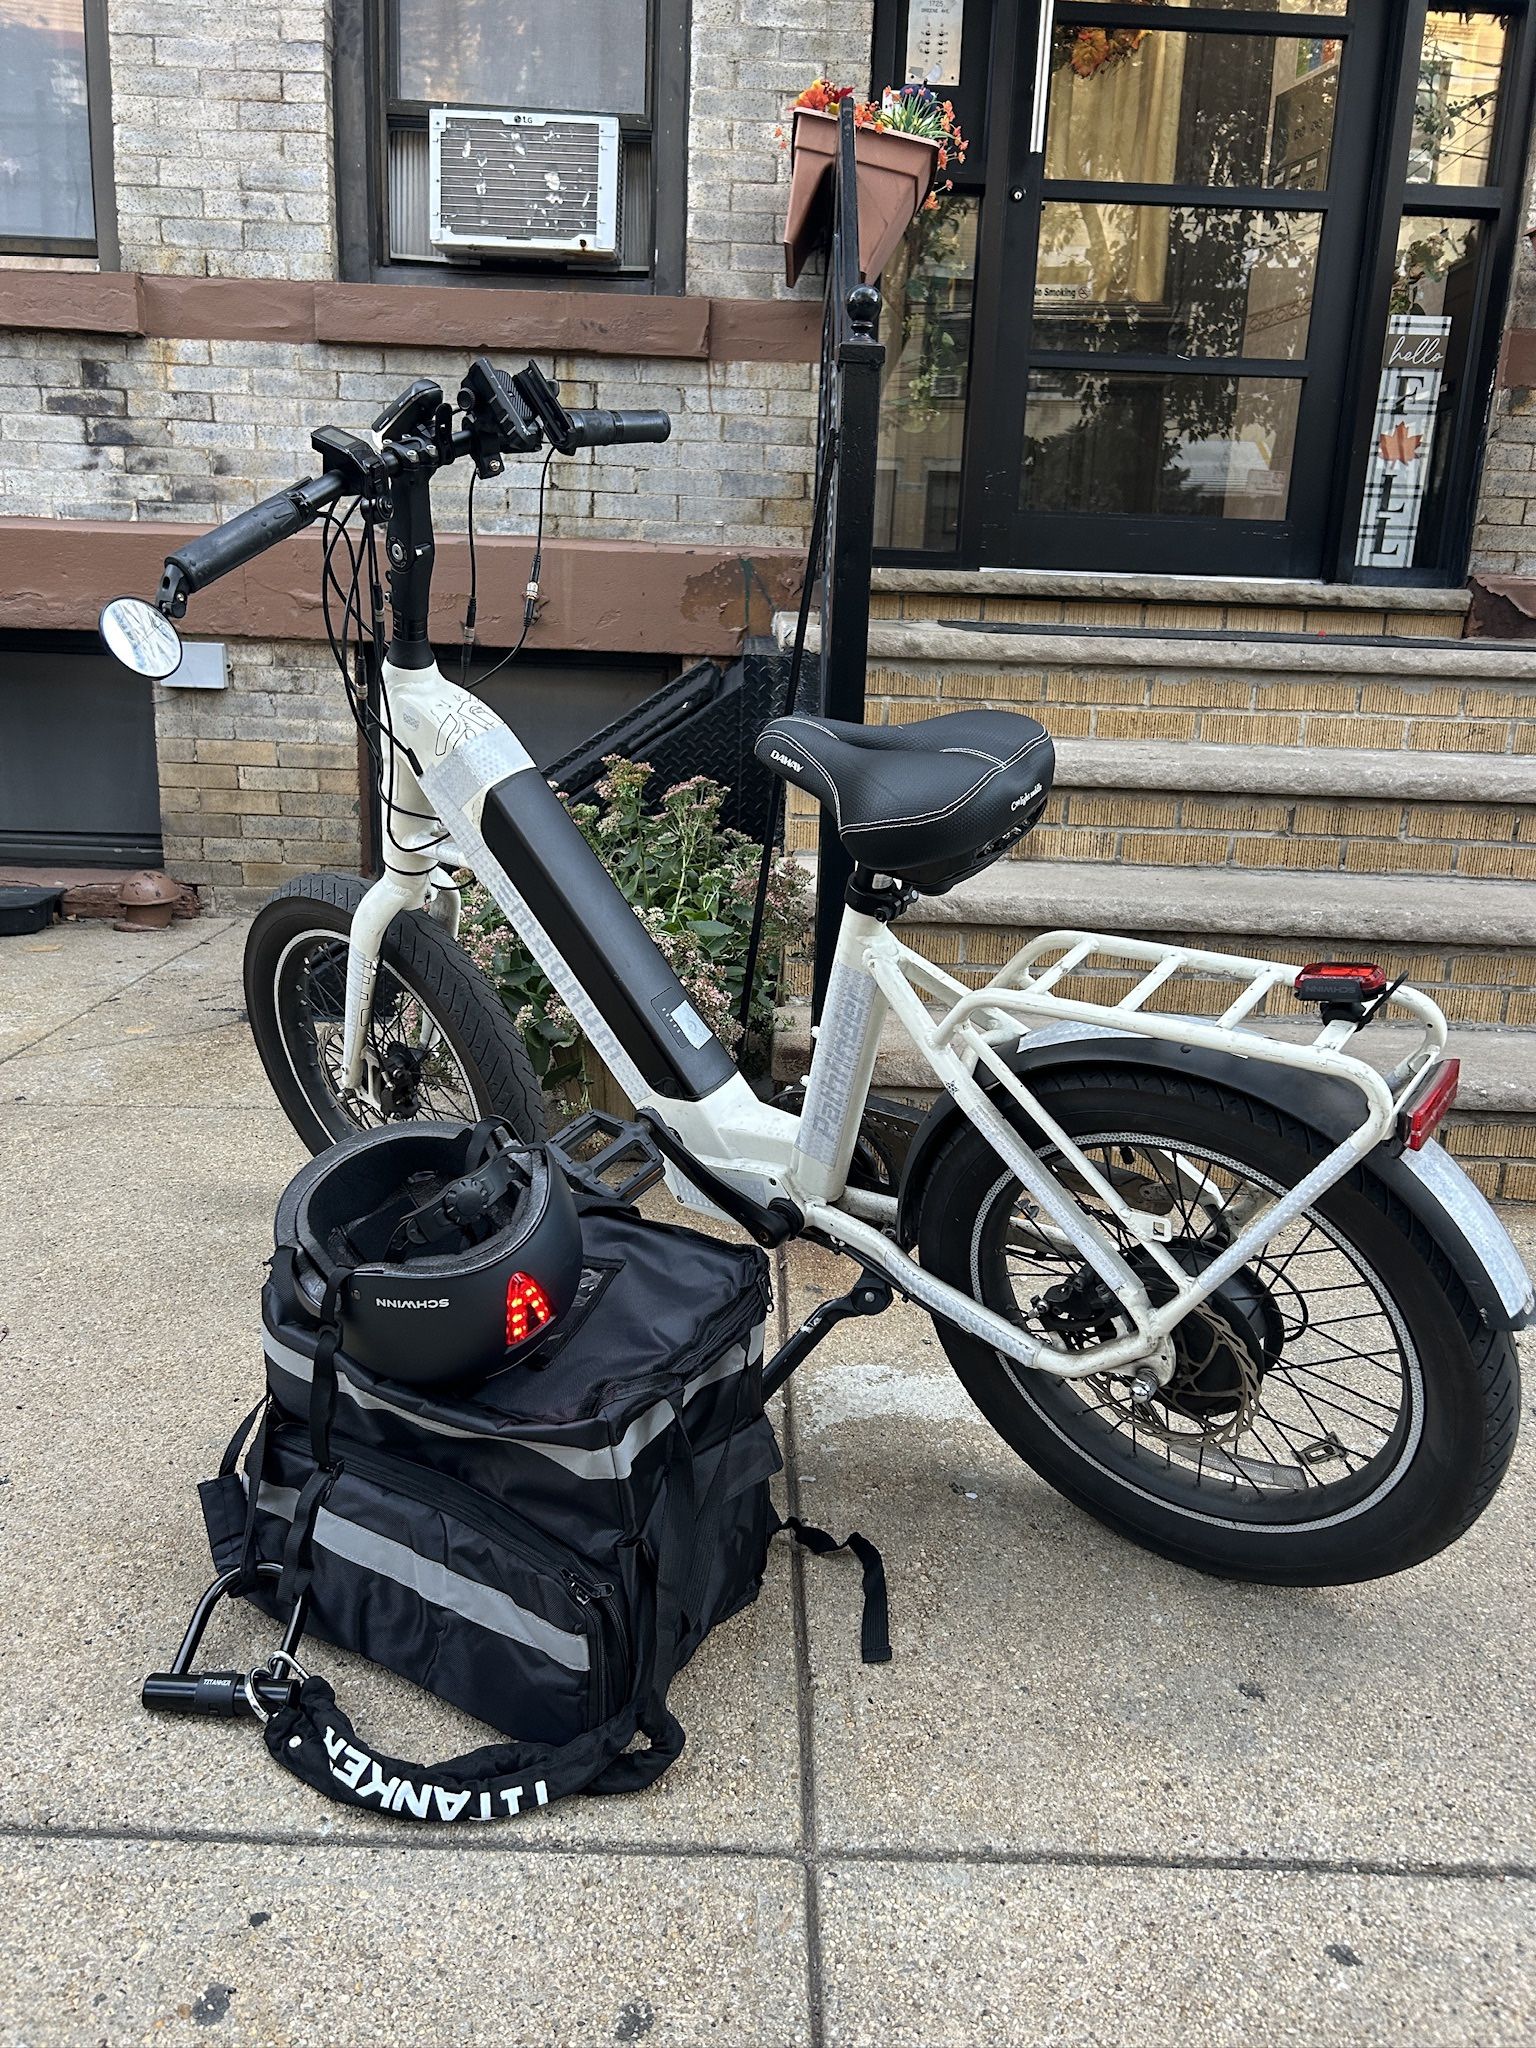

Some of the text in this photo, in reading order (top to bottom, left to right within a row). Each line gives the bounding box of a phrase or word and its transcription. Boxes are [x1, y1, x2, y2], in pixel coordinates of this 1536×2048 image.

[1044, 287, 1076, 299] Smoking
[1388, 335, 1445, 365] hello
[770, 749, 804, 773] DAWAY
[1304, 985, 1357, 994] SCHWINN
[375, 1297, 450, 1309] SCHWINN
